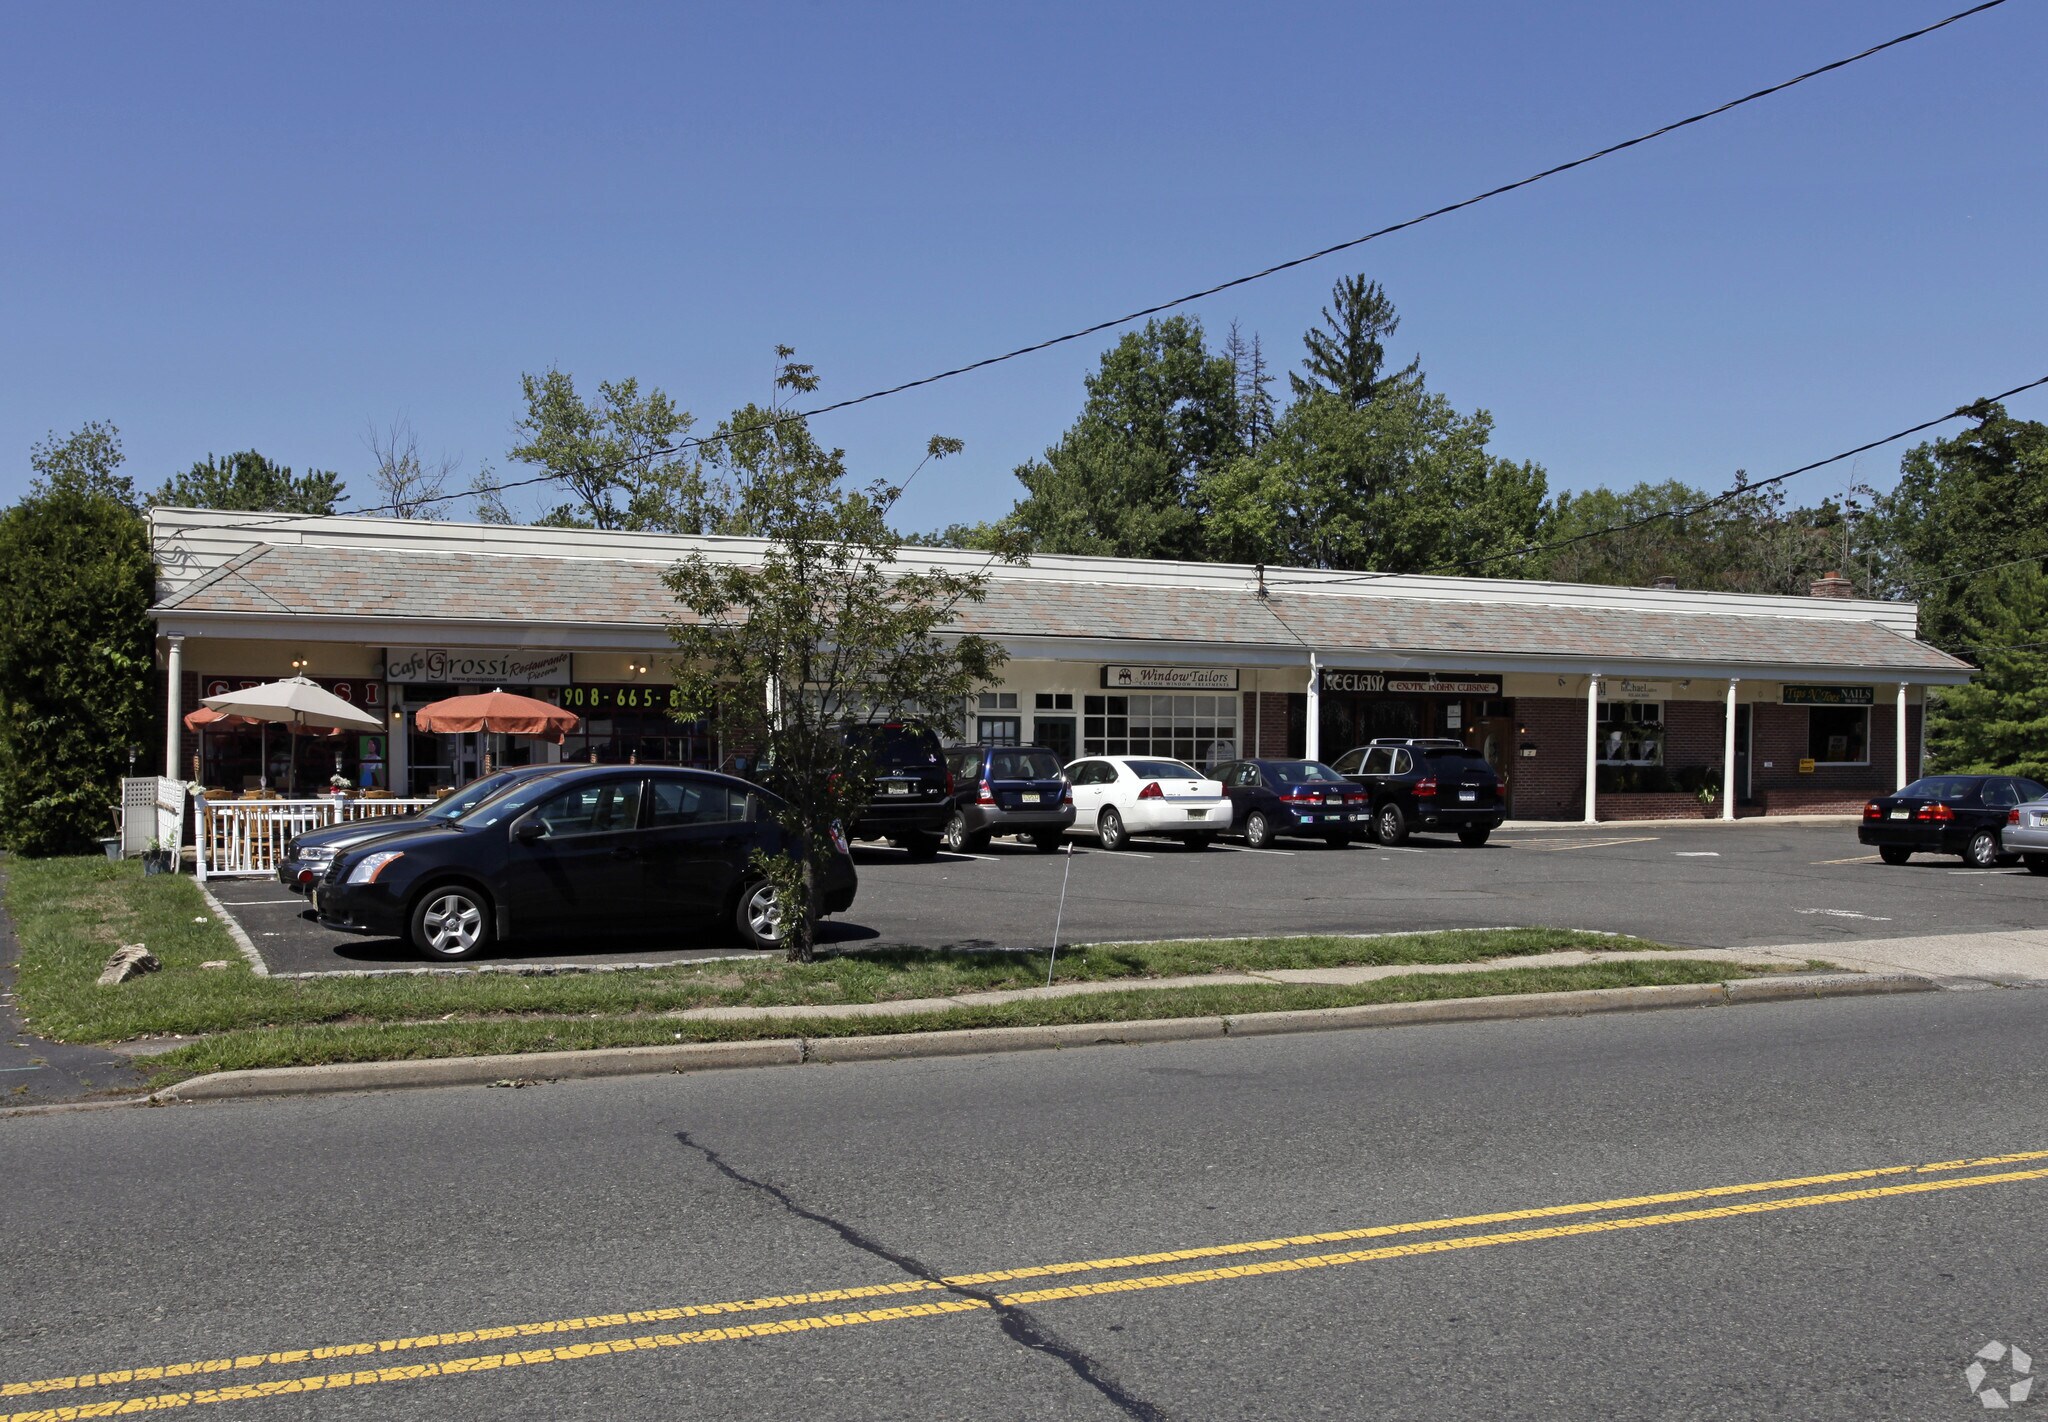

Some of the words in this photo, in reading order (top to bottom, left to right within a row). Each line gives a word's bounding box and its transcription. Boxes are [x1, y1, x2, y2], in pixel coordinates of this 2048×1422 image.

[427, 651, 508, 679] Grossi
[1396, 682, 1426, 692] EXOTIC
[1428, 683, 1455, 692] INDIAN
[1457, 684, 1490, 693] CUISINE
[1840, 688, 1871, 698] NAILS
